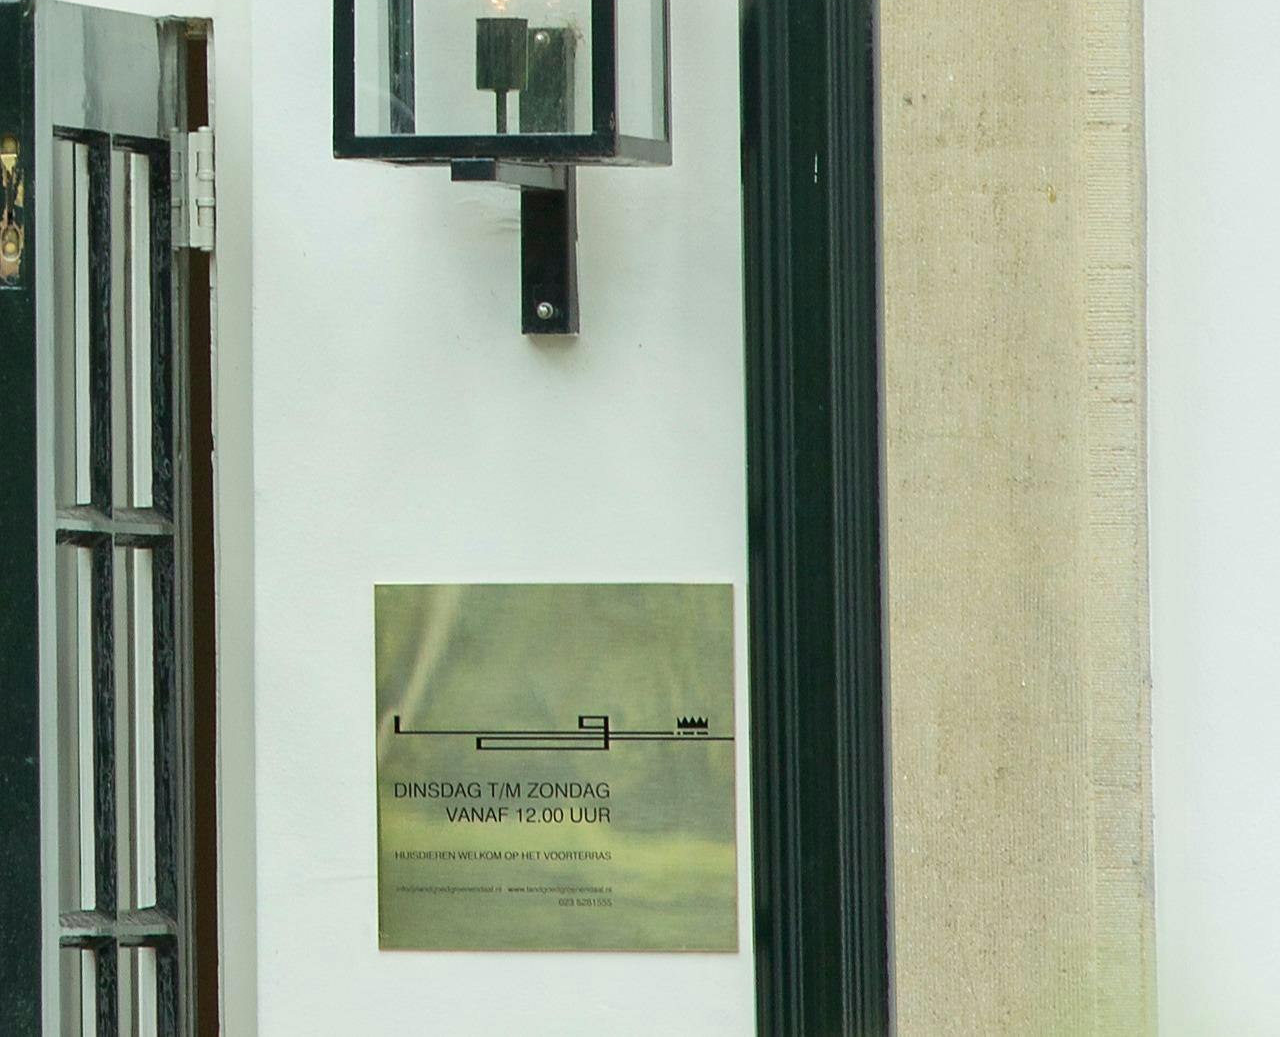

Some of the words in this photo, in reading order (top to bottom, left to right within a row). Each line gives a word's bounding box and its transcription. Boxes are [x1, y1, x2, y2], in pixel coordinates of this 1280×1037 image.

[394, 782, 482, 799] DINSDAG
[487, 782, 521, 800] T/M
[527, 782, 611, 798] ZONDAG
[446, 807, 508, 823] VANAF
[517, 807, 564, 823] 12.00
[569, 807, 611, 823] UUR
[394, 850, 456, 860] HUISDIEREN
[458, 850, 502, 860] WELKOM
[504, 850, 519, 860] OP
[521, 850, 540, 860] HET
[543, 850, 612, 861] VOORTERRAS
